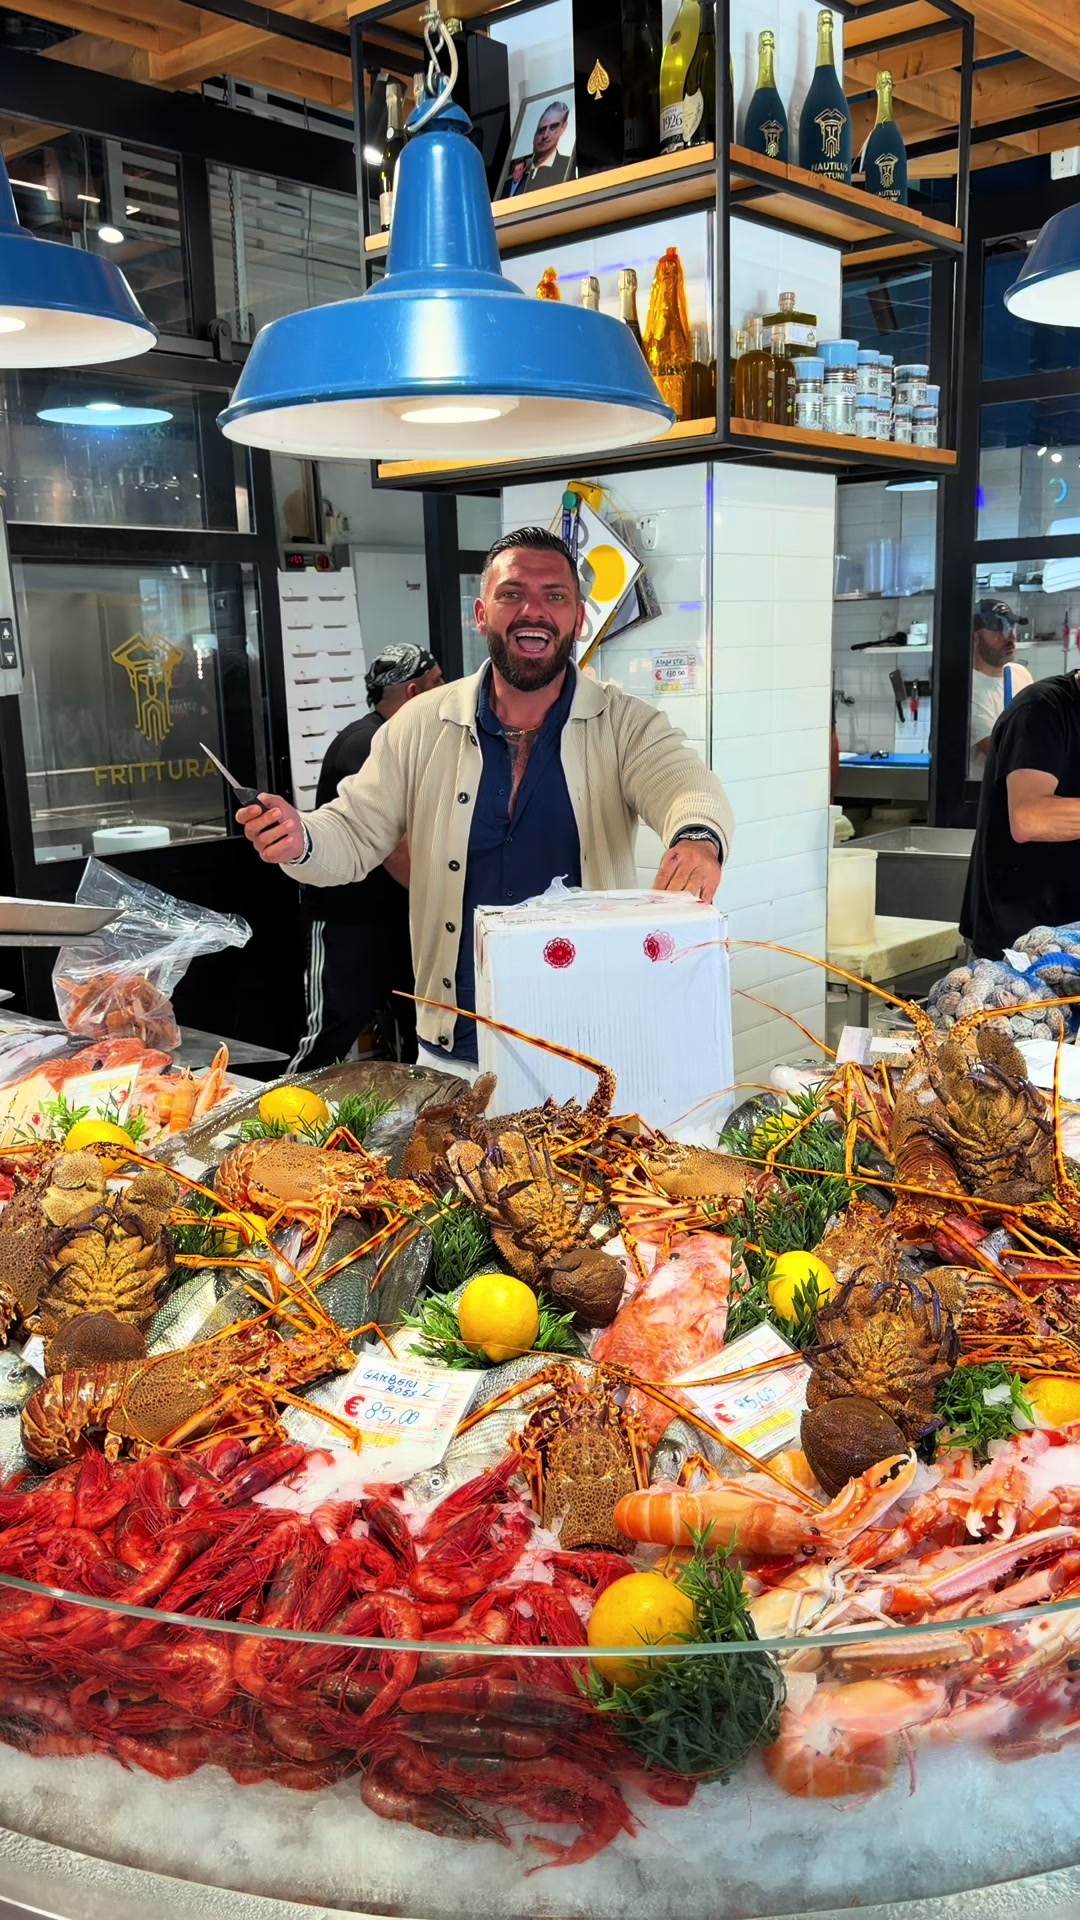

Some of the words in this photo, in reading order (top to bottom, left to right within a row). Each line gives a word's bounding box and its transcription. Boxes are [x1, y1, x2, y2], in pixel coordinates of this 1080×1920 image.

[811, 162, 849, 172] NAUTILUS
[94, 759, 219, 787] FRITTURA
[343, 1395, 367, 1418] €
[364, 1402, 420, 1425] 85,00
